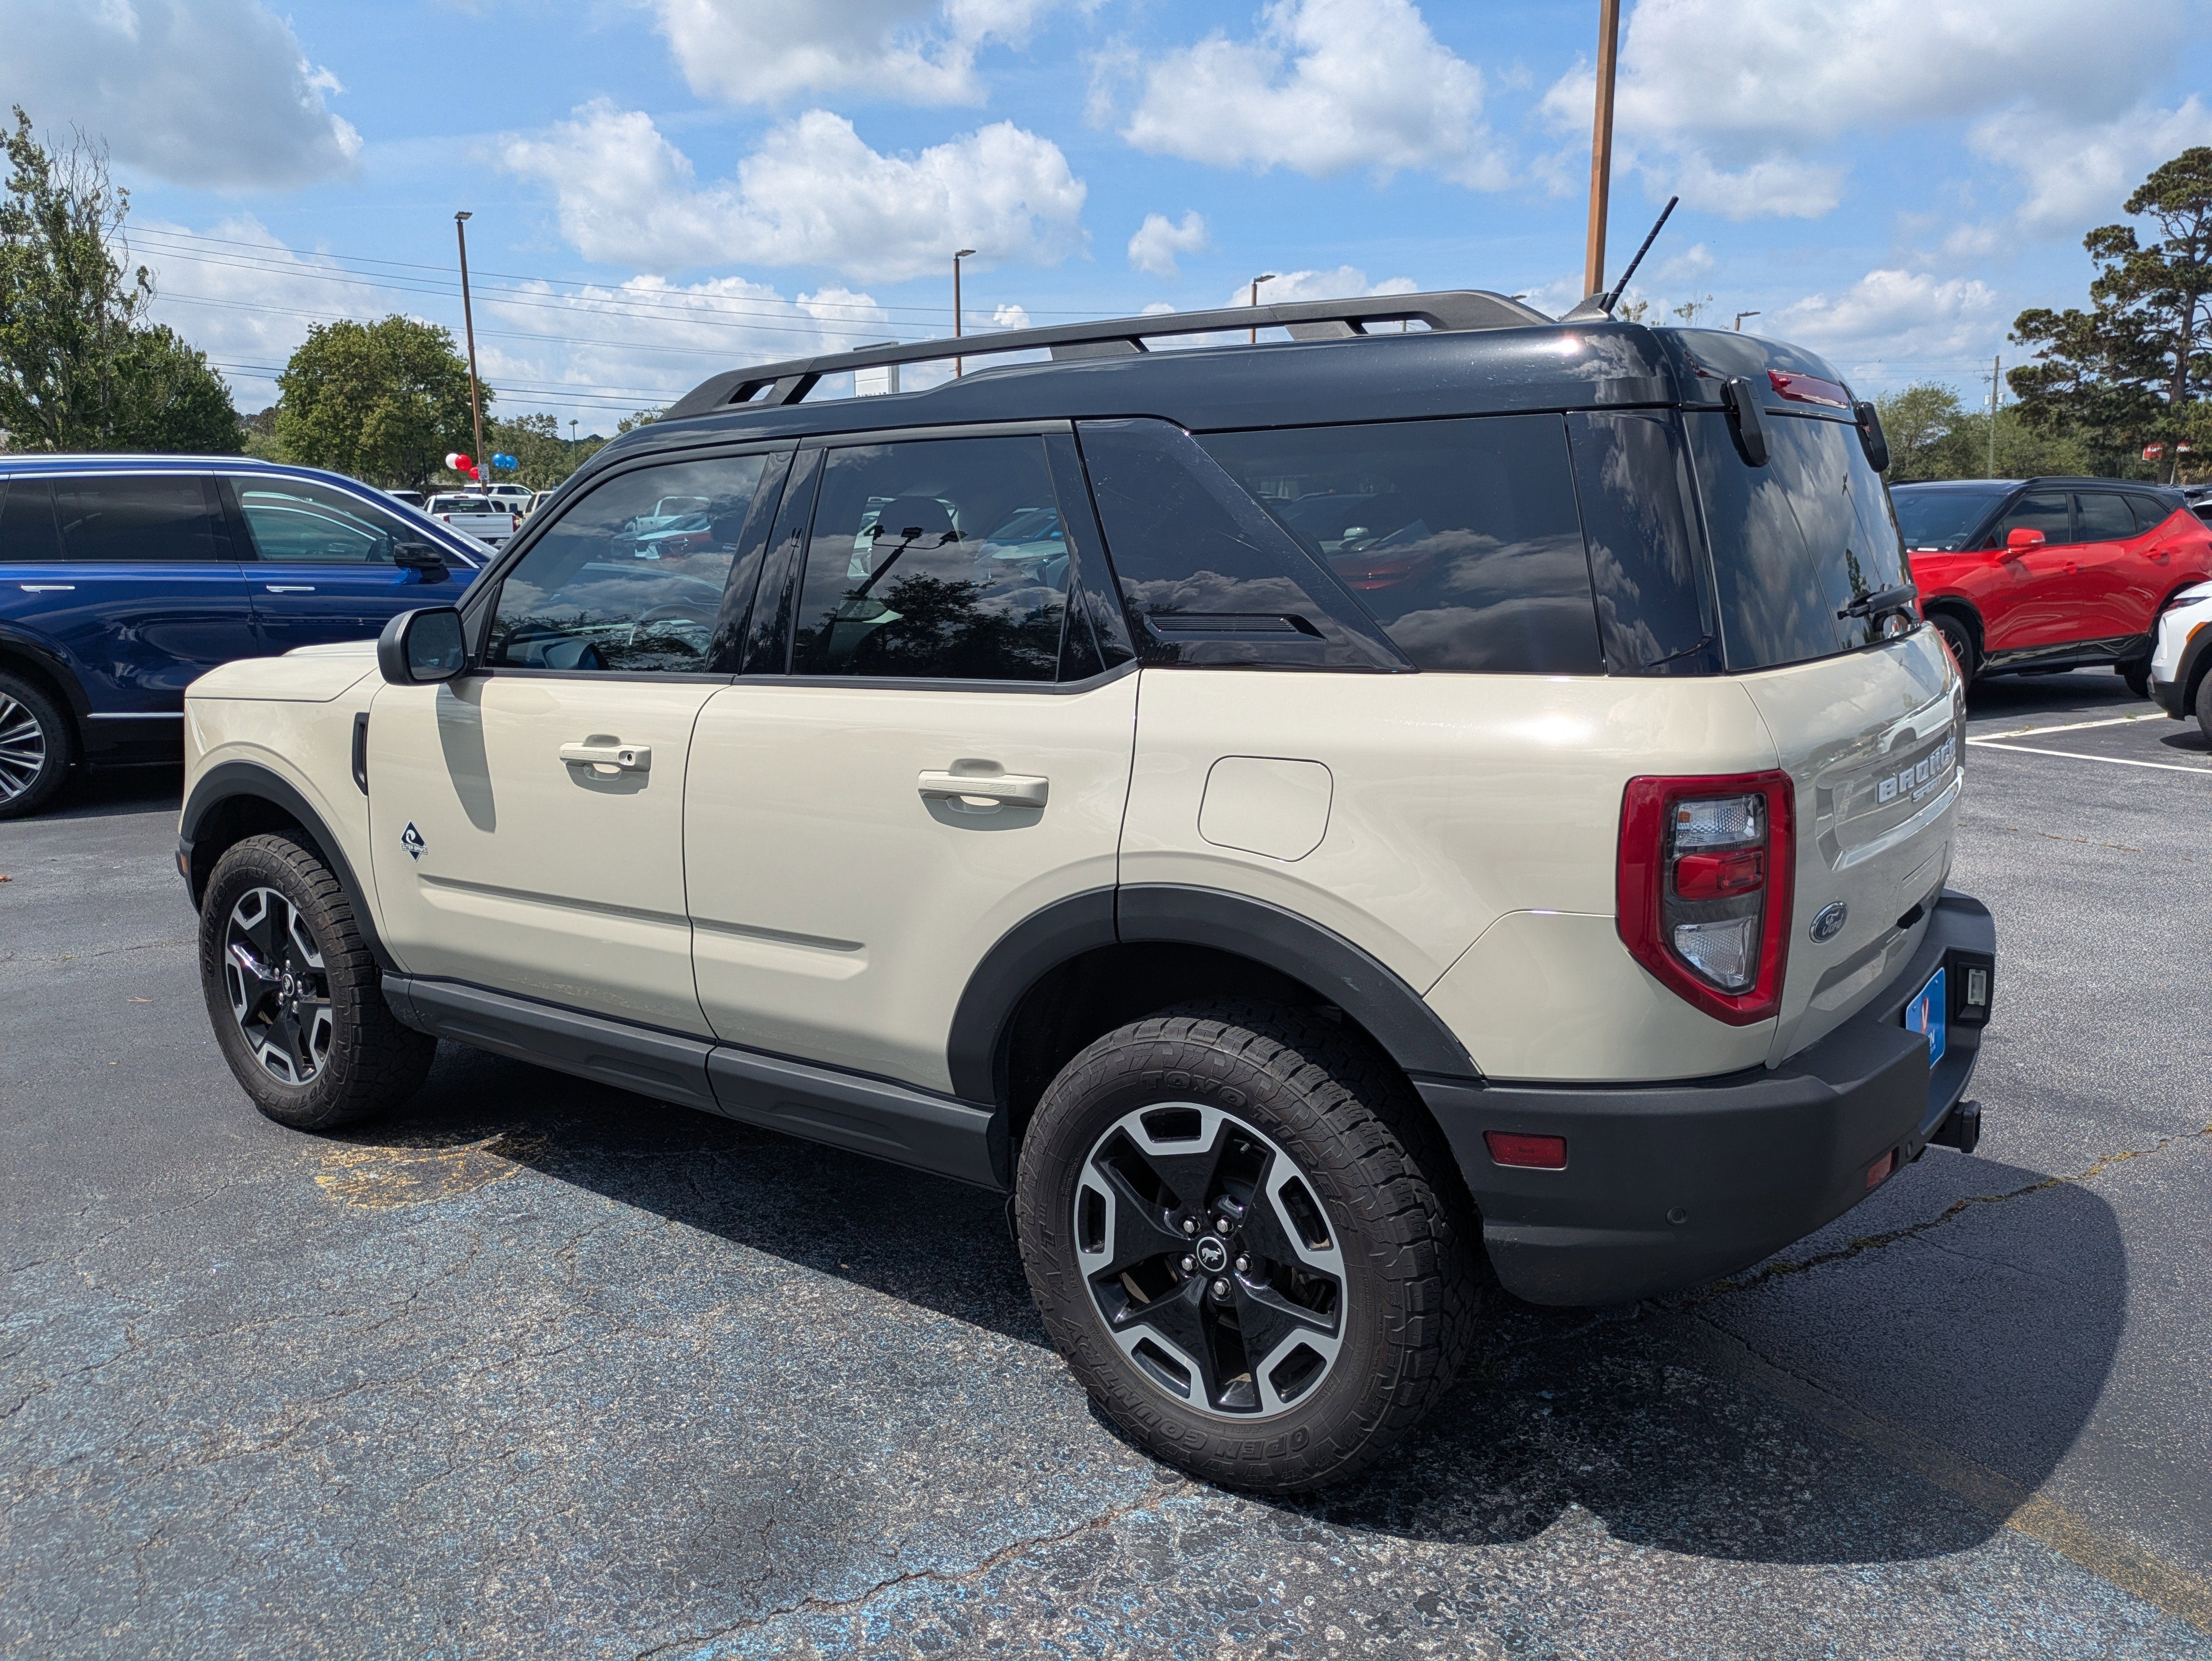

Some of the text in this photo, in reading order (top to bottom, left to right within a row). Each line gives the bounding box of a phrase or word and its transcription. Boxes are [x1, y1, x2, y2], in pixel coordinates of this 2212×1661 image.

[1878, 737, 1956, 804] BRONCO
[1822, 911, 1844, 936] Ford
[1140, 1070, 1359, 1233] TOYO TIRES
[1063, 1317, 1208, 1451] COUNTRY
[1214, 1425, 1309, 1460] OPEN
